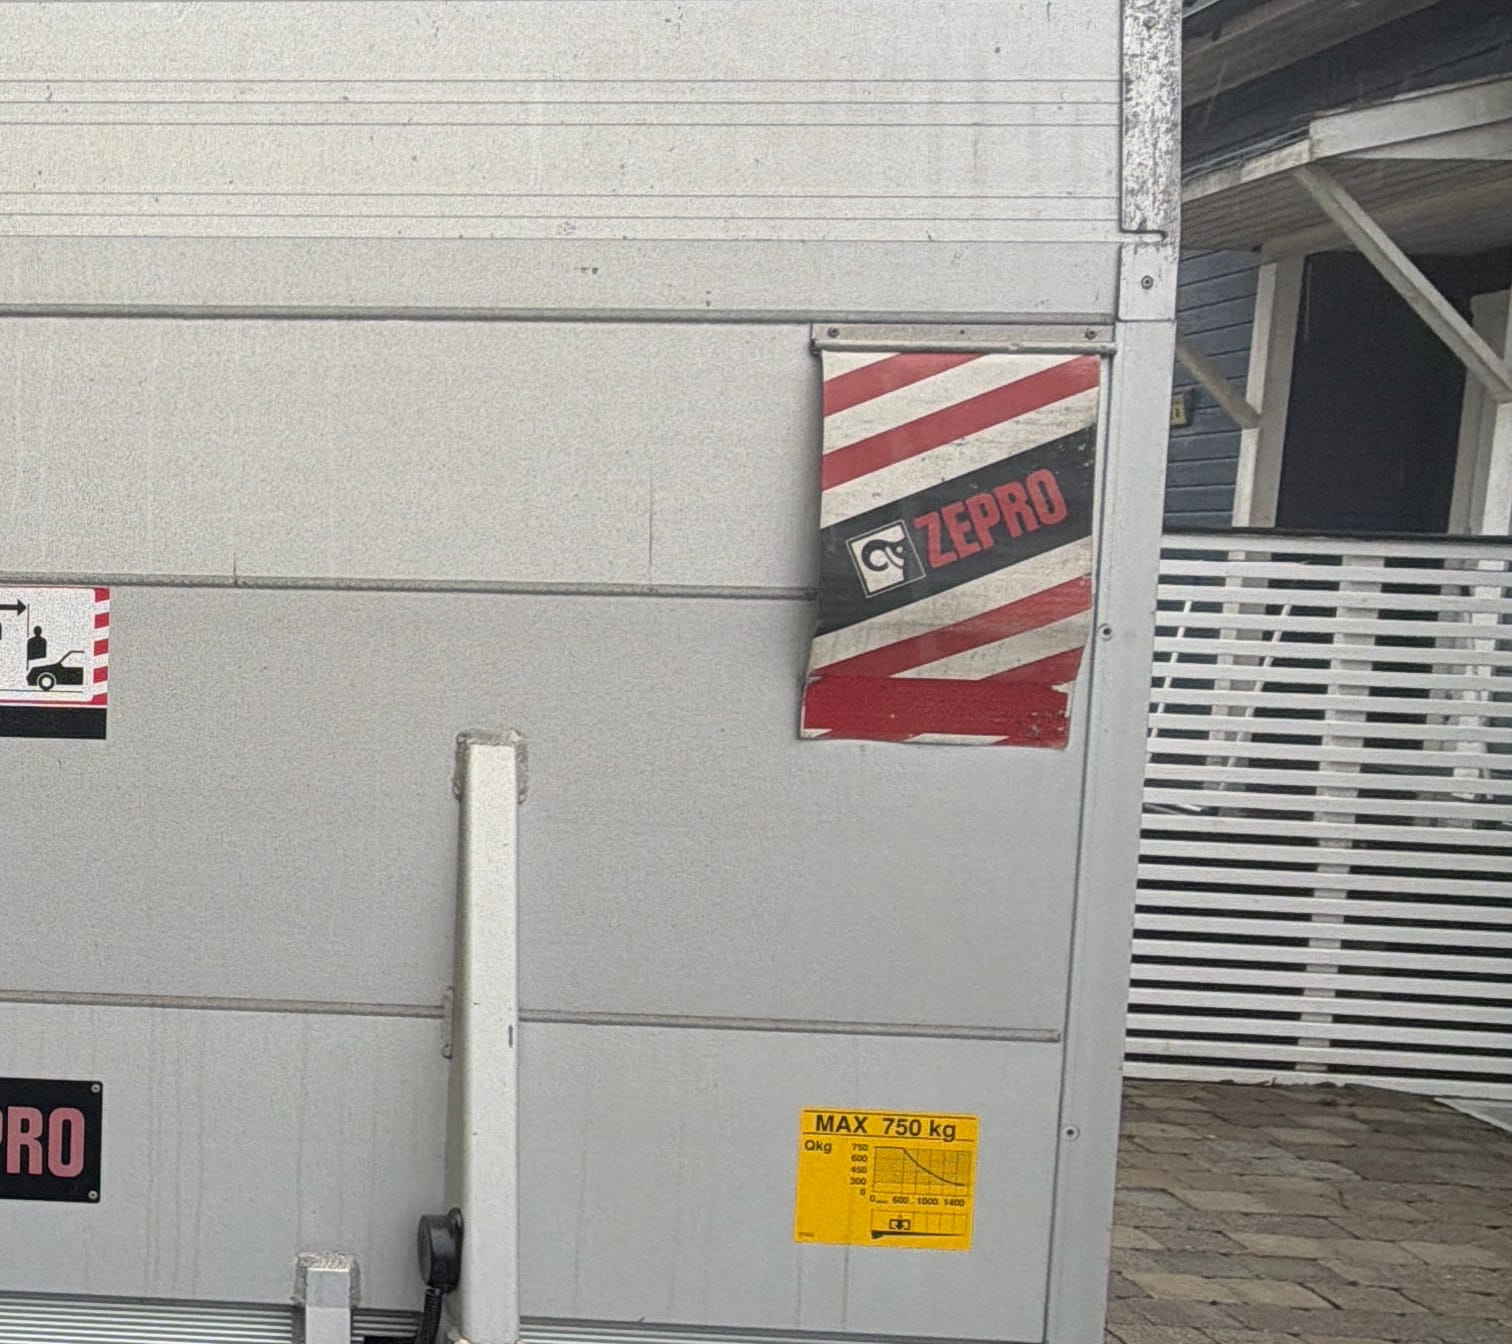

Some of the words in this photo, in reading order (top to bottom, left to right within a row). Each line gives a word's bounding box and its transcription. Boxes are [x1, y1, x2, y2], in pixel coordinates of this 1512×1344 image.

[914, 468, 1069, 568] ZEPRO
[815, 1114, 868, 1134] MAX
[882, 1118, 922, 1137] 750
[929, 1120, 957, 1143] kg
[804, 1139, 833, 1155] Qkg
[851, 1143, 869, 1152] 750
